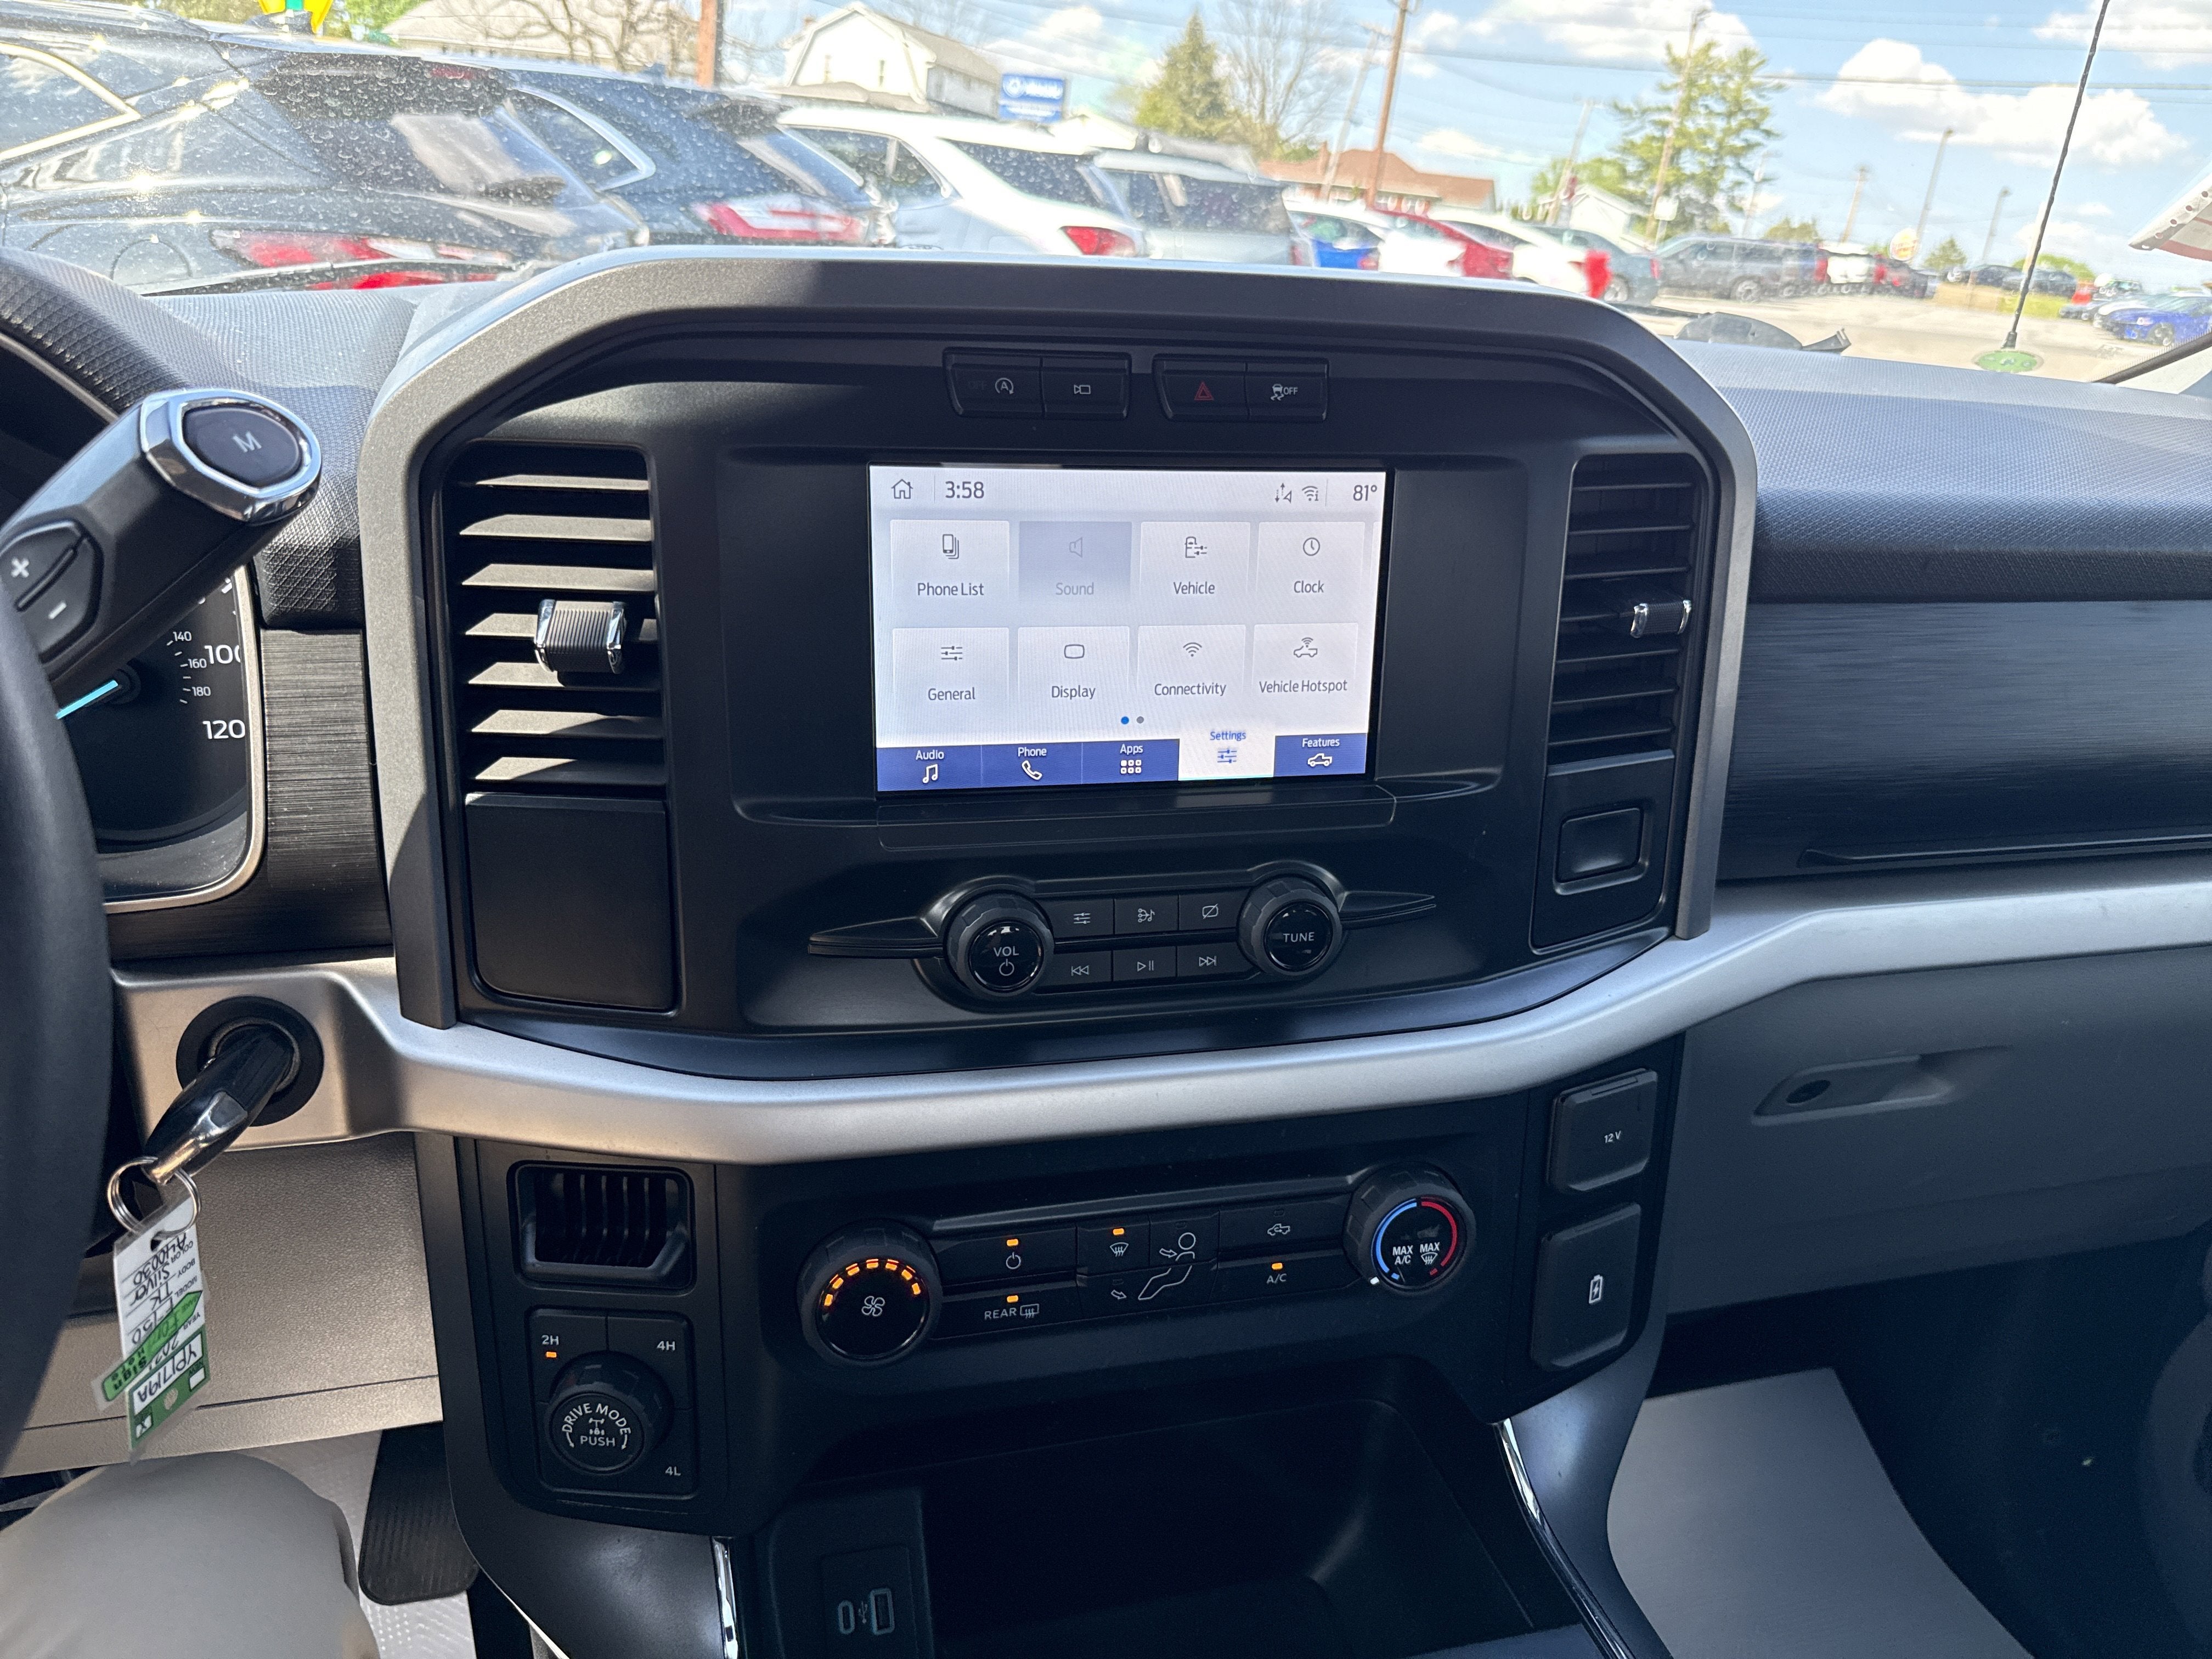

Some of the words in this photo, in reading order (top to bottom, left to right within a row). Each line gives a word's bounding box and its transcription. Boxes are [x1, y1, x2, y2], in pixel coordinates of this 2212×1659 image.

[233, 432, 261, 452] M
[946, 481, 984, 498] 3:58
[1353, 485, 1377, 501] 81°
[918, 583, 958, 595] Phone
[962, 583, 984, 595] List
[1056, 582, 1094, 595] Sound
[1173, 582, 1215, 594] Vehicle
[1294, 580, 1324, 593] Clock
[173, 631, 192, 641] 140
[188, 658, 207, 669] 160
[192, 686, 211, 697] 180
[1052, 685, 1096, 699] Display
[1155, 682, 1226, 696] Connectivity
[1259, 680, 1299, 692] Vehicle
[1302, 680, 1347, 693] Hotspot
[928, 687, 975, 700] General
[202, 719, 246, 740] 120
[1210, 731, 1246, 741] Settings
[1302, 738, 1340, 747] Features
[916, 750, 944, 759] Audio
[1018, 747, 1046, 756] Phone
[1120, 744, 1143, 754] Apps
[1283, 932, 1314, 942] TUNE
[994, 946, 1019, 956] VOL
[171, 1240, 194, 1263] COLOR
[1392, 1245, 1413, 1256] MAX
[1420, 1242, 1440, 1253] MAX
[1395, 1255, 1412, 1265] A/C
[178, 1258, 196, 1278] BODY
[1267, 1274, 1286, 1283] A/C
[174, 1276, 198, 1297] MODEL
[985, 1308, 1017, 1319] REAR
[183, 1312, 201, 1330] YEAR
[541, 1335, 559, 1345] 2H
[656, 1340, 676, 1351] 4H
[112, 1356, 147, 1390] Sign
[562, 1403, 592, 1433] DRIVE
[595, 1403, 631, 1435] MODE
[580, 1435, 616, 1447] PUSH
[665, 1466, 680, 1476] 4L
